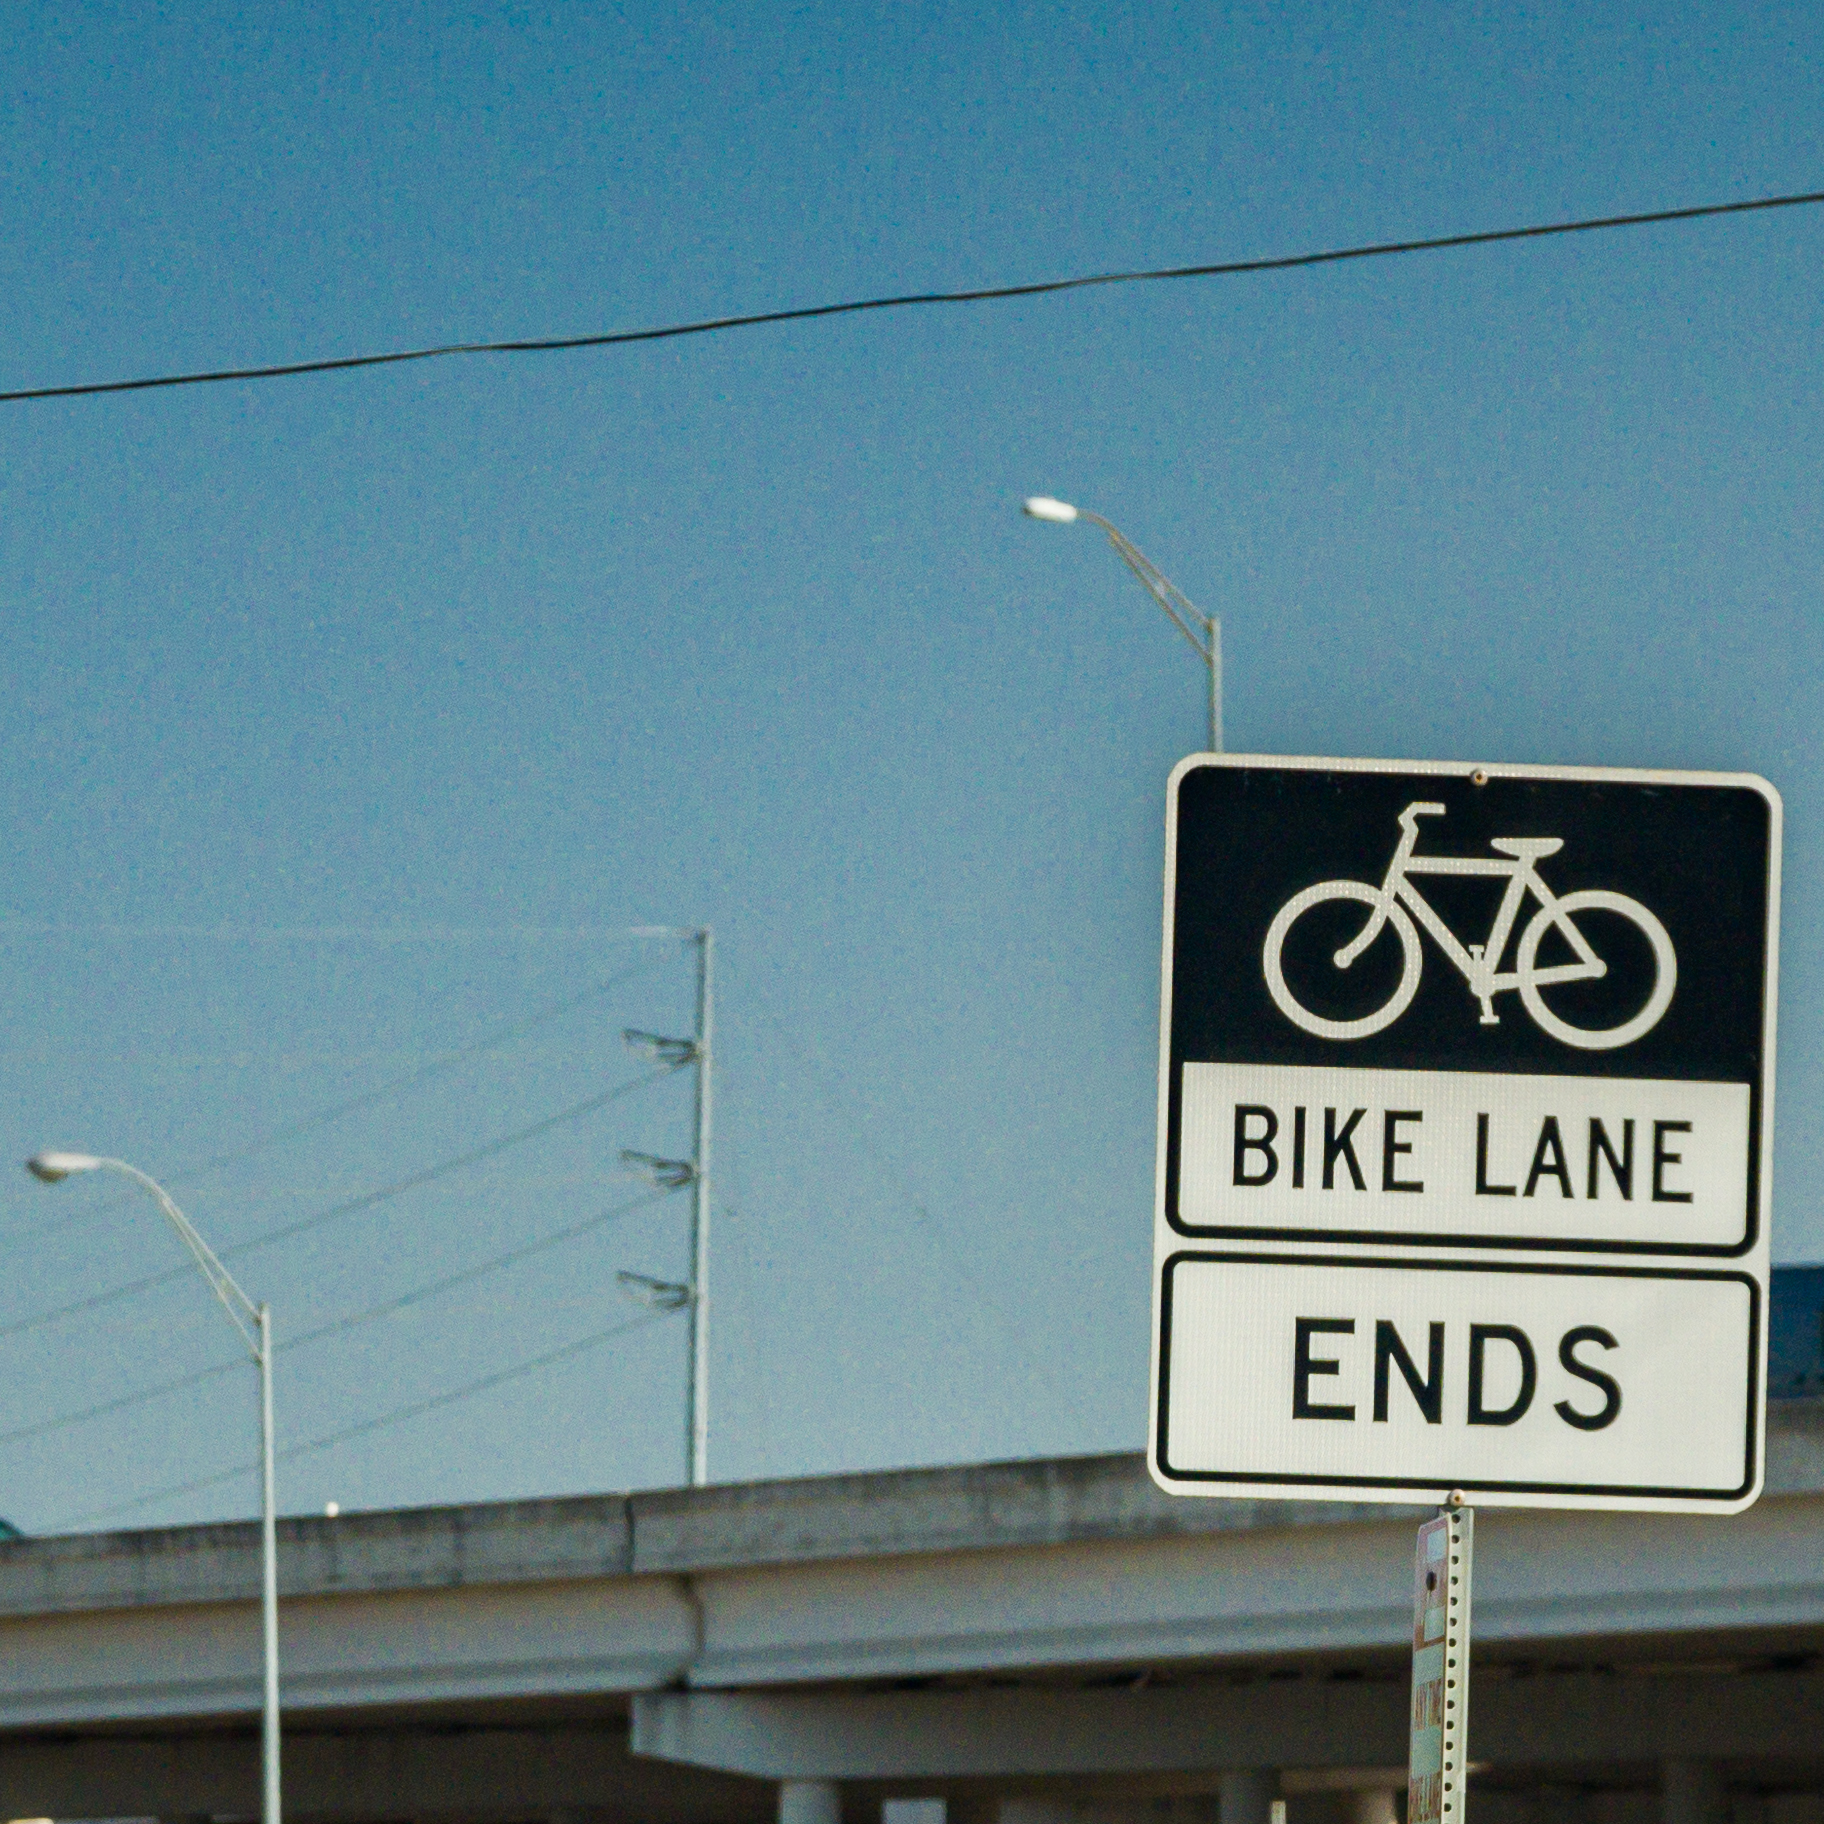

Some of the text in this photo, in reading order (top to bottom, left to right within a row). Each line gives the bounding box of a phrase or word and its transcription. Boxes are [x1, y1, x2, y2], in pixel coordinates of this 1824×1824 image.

[1232, 1103, 1695, 1204] BIKE LANE
[1291, 1315, 1623, 1432] ENDS
